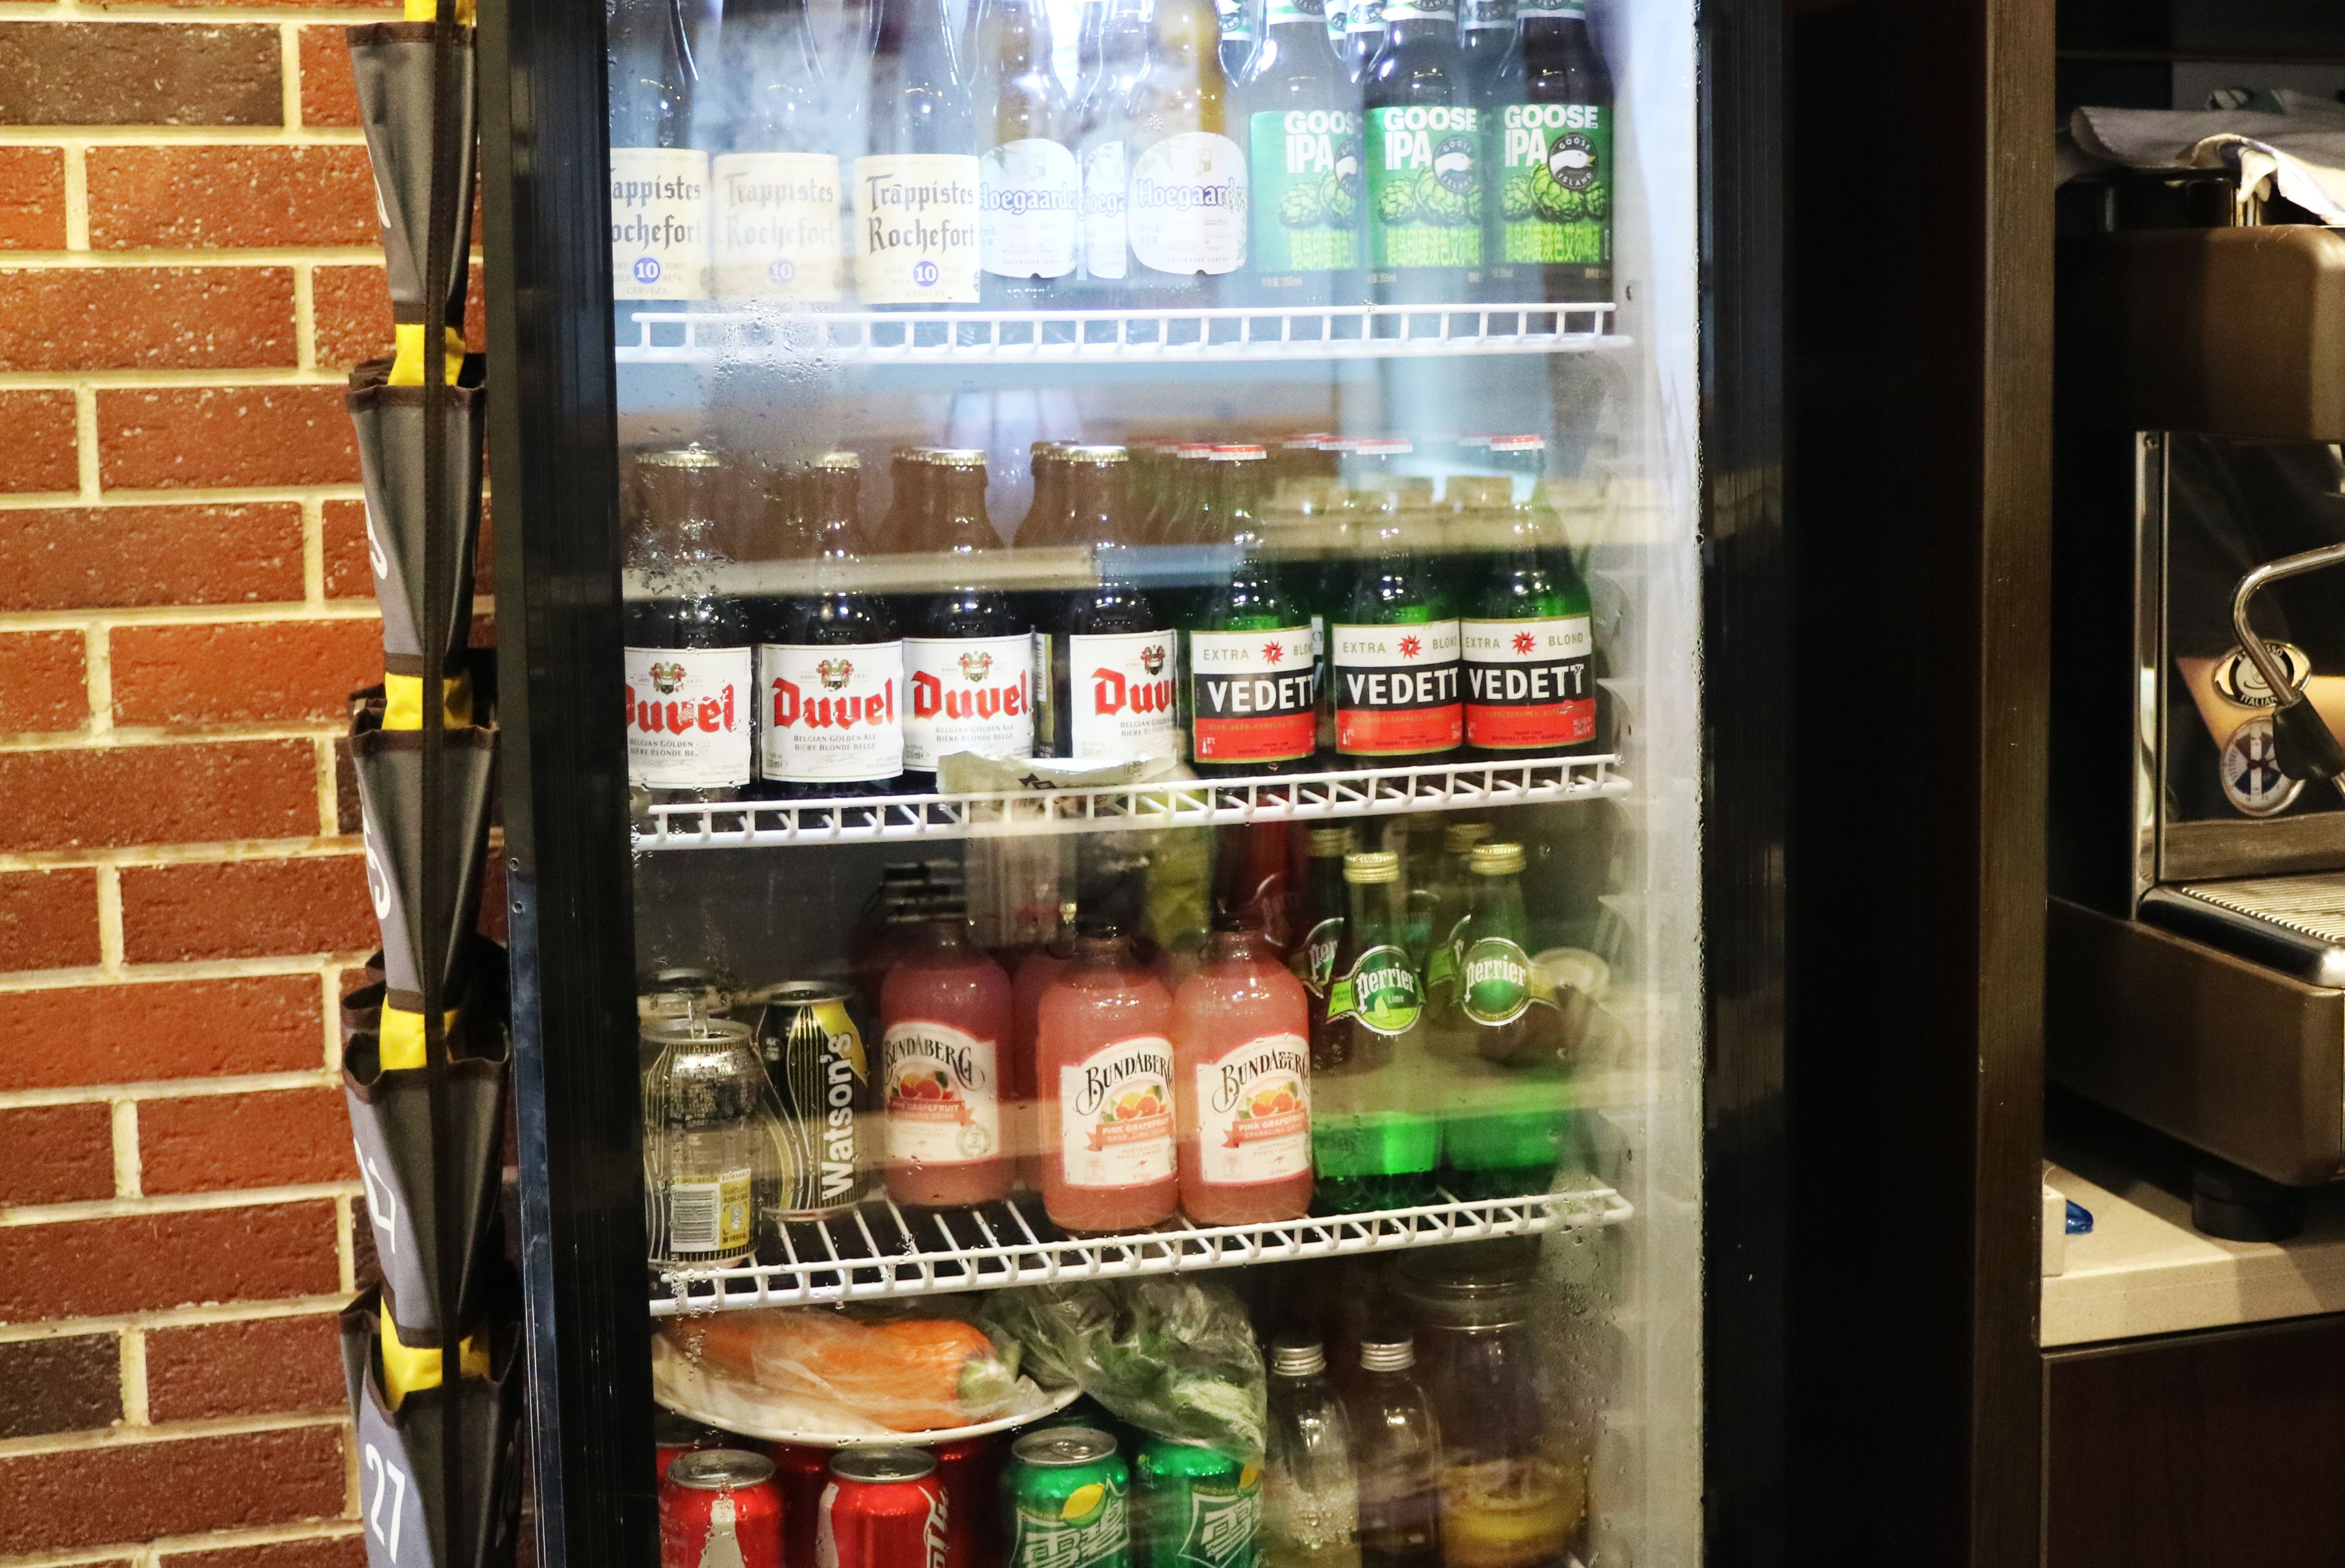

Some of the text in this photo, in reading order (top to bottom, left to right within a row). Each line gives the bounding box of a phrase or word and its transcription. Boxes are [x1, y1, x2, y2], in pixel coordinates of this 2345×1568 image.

[1384, 106, 1477, 132] GOOSE
[1505, 104, 1598, 129] GOOSE
[1286, 134, 1334, 173] IPA
[1384, 130, 1433, 170] IPA
[1504, 128, 1547, 167] IPA
[1559, 137, 1591, 150] GOOSE
[611, 168, 700, 208] appistes
[724, 172, 833, 210] Trappistes
[865, 174, 974, 213] Trappistes
[1557, 172, 1592, 186] ISLAND
[612, 214, 707, 251] ochefort
[725, 214, 836, 252] Rochefort
[867, 217, 974, 256] Rochefort
[636, 262, 659, 278] 10
[771, 263, 793, 280] 10
[916, 266, 937, 281] 10
[1203, 649, 1249, 660] EXTRA
[1343, 642, 1386, 653] EXTRA
[1466, 633, 1583, 649] EXTRA BLOND
[911, 669, 1028, 720] Duvel
[1347, 667, 1458, 705] VEDETT
[1469, 664, 1585, 699] VEDETT
[771, 677, 895, 730] Duvel
[2239, 694, 2278, 707] ITALIAN
[794, 734, 827, 742] BELGIAN
[936, 725, 970, 734] BELGIAN
[994, 732, 1014, 741] BELGE
[853, 742, 876, 750] BELGE
[1356, 962, 1415, 1015] perrier
[1464, 954, 1527, 1003] perrier
[1387, 994, 1405, 1003] Lime
[885, 1034, 986, 1092] BUNDABERG
[821, 1033, 854, 1201] Watson's
[1102, 1126, 1124, 1135] PINK
[1239, 1122, 1260, 1131] PINK
[366, 1443, 405, 1564] 27
